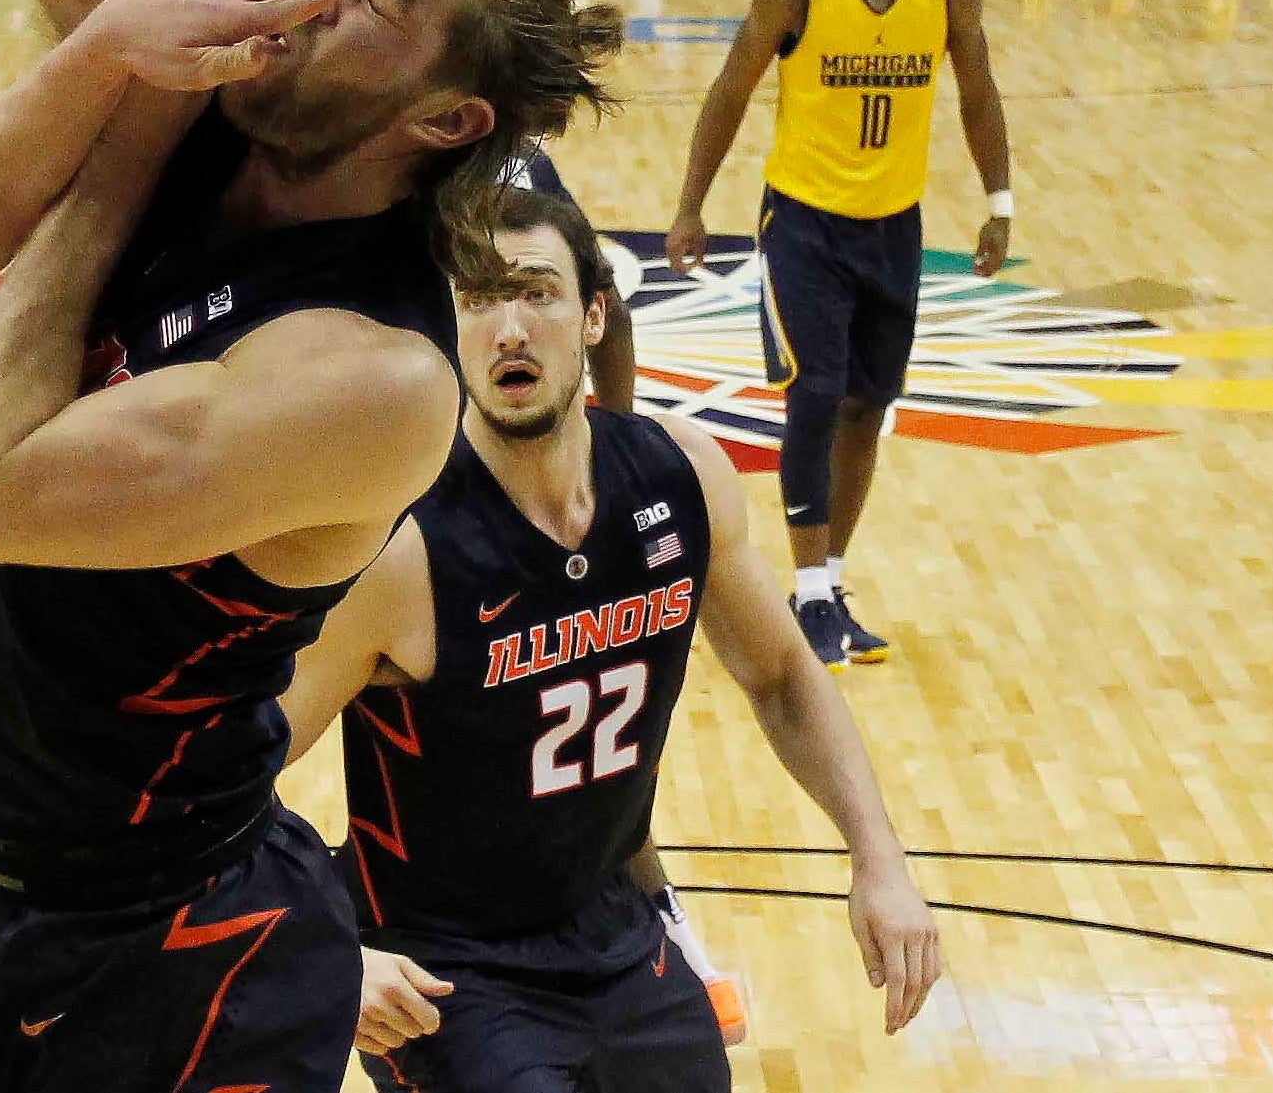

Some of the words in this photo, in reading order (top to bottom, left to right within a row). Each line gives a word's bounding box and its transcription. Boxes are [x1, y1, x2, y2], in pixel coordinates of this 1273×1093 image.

[821, 54, 934, 74] MICHIGAN
[860, 94, 891, 149] 10
[483, 578, 693, 688] ILLINOIS
[531, 661, 649, 798] 22
